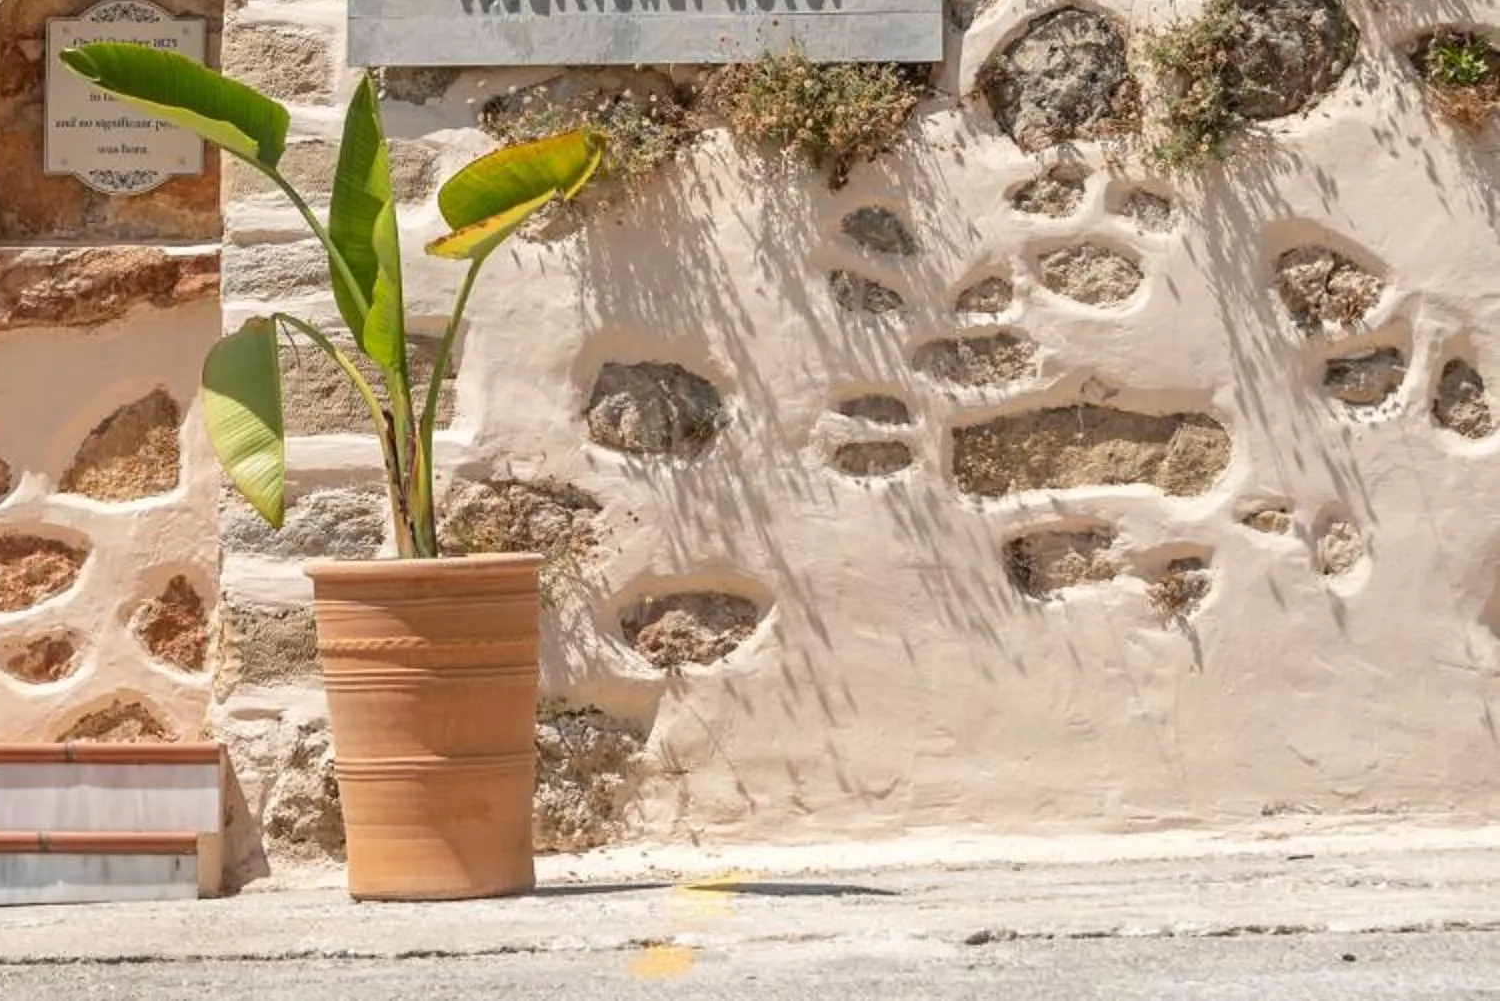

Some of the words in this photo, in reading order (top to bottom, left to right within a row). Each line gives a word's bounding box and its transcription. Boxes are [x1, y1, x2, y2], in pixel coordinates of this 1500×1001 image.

[55, 116, 77, 128] and
[95, 116, 152, 131] significant
[97, 145, 119, 154] was
